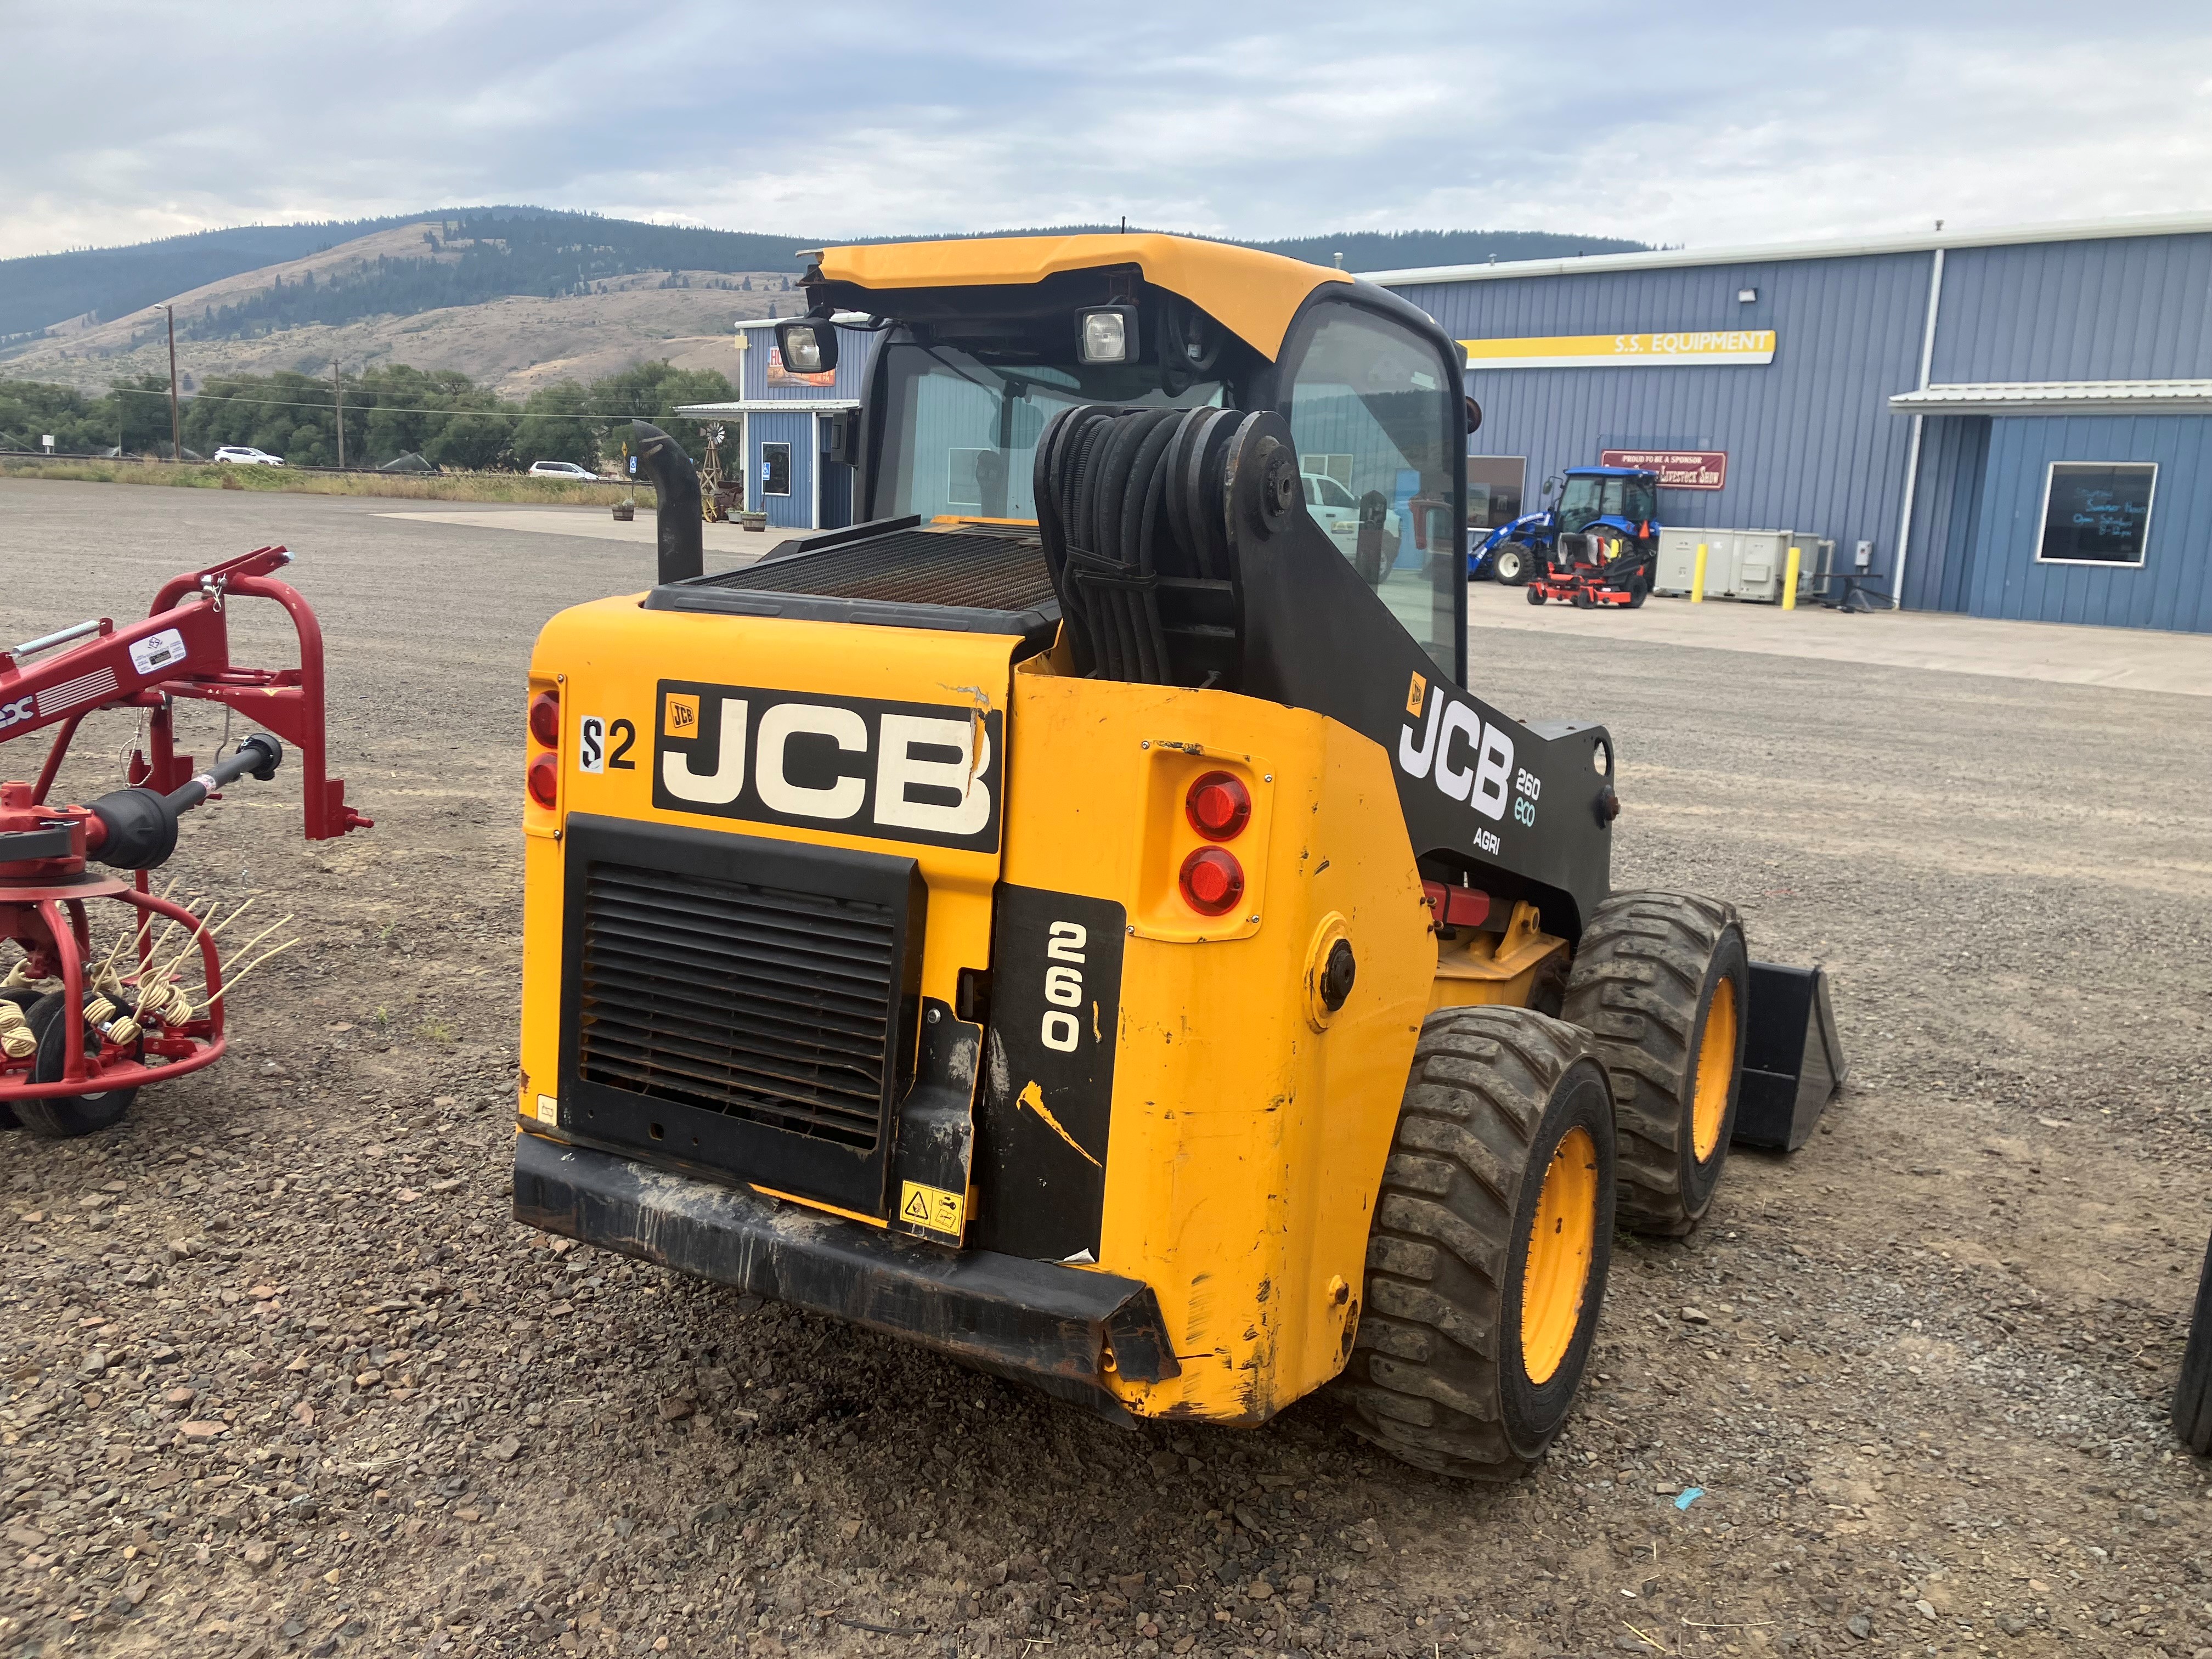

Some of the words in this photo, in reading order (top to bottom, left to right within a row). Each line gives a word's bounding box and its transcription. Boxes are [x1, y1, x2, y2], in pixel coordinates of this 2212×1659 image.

[1615, 335, 1644, 352] S.S.
[1652, 331, 1771, 354] EQUIPMENT
[1700, 466, 1720, 484] SHOW
[1412, 682, 1421, 703] JCB
[674, 704, 693, 725] JCB
[663, 698, 991, 836] JCB
[1398, 685, 1514, 821] JCB
[1515, 767, 1542, 800] 260
[1514, 797, 1536, 827] eco
[1473, 827, 1501, 856] AGRI
[1041, 920, 1087, 1053] 260
